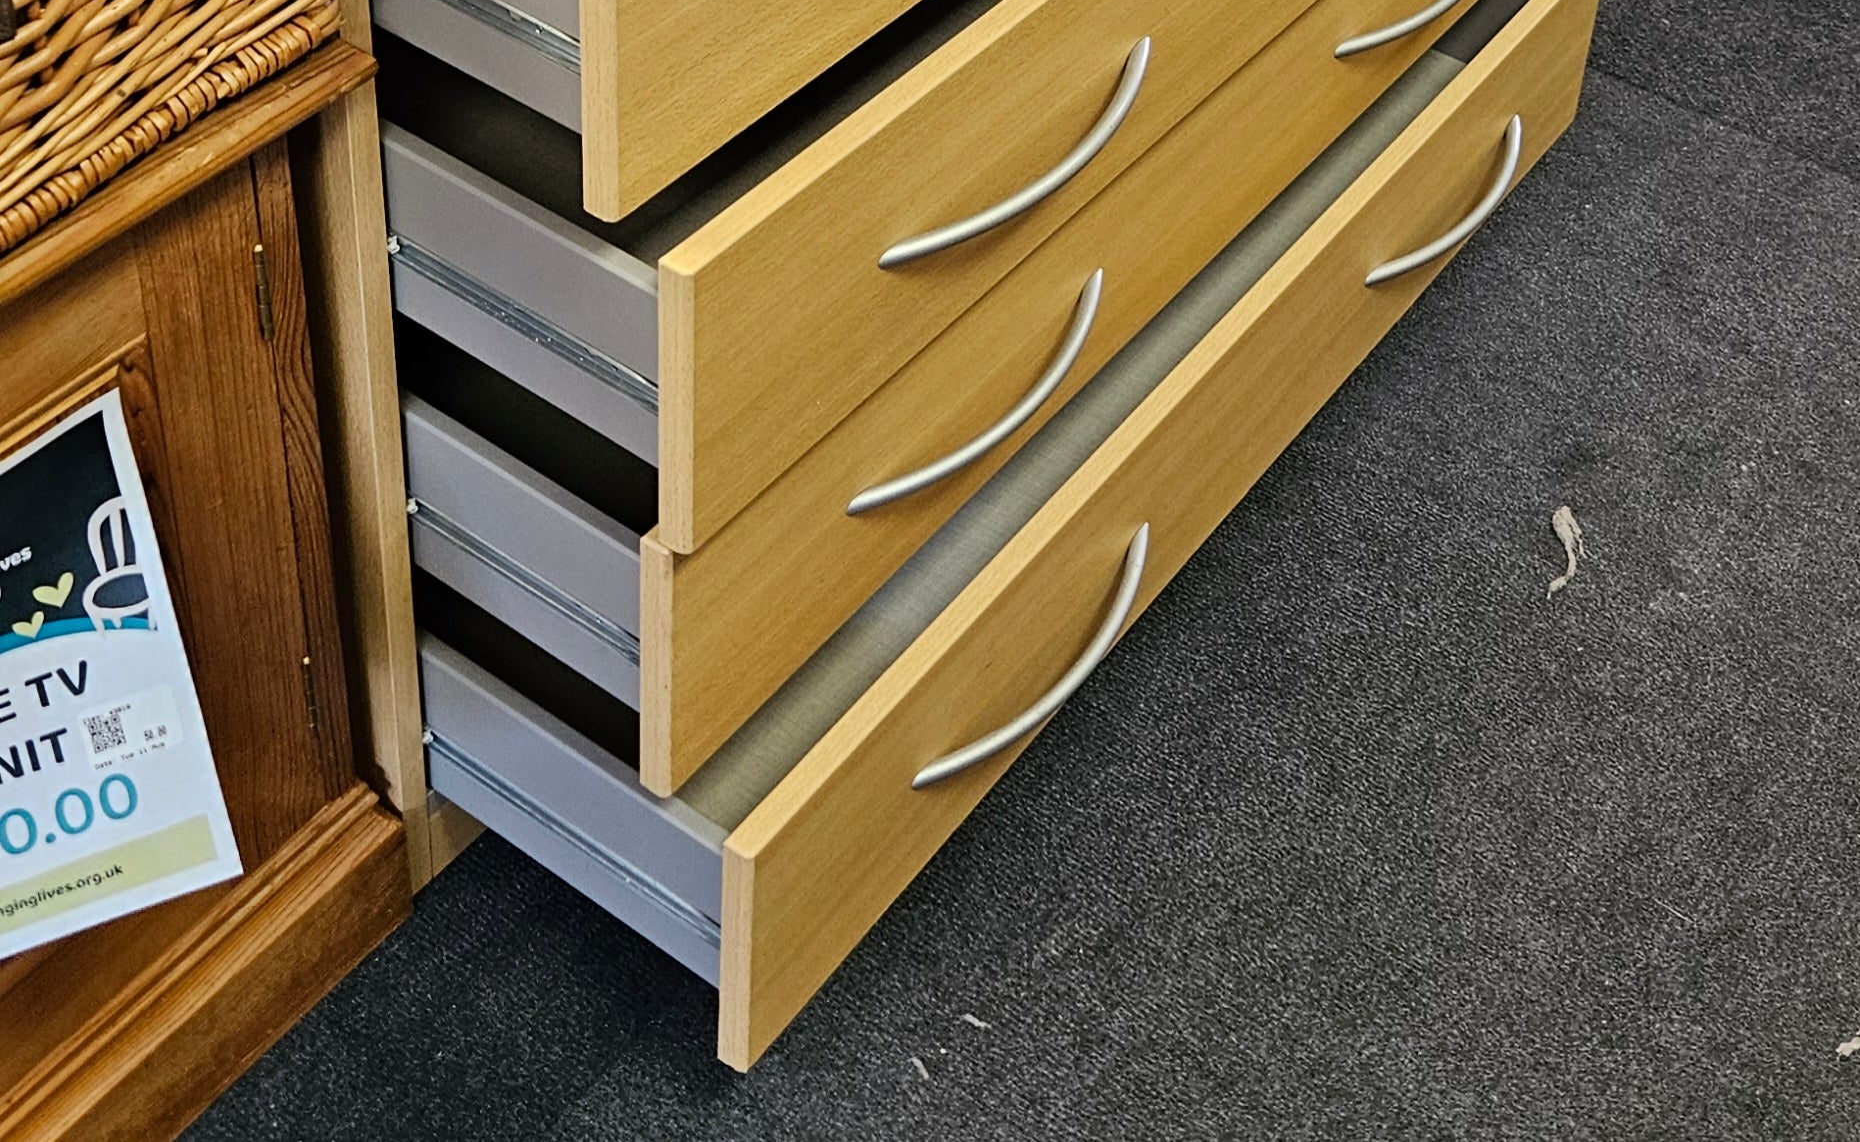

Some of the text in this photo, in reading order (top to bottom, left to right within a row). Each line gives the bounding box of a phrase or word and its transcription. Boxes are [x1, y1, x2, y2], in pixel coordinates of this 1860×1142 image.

[25, 660, 87, 707] TV
[0, 728, 67, 784] NIT
[0, 773, 138, 854] 0.00
